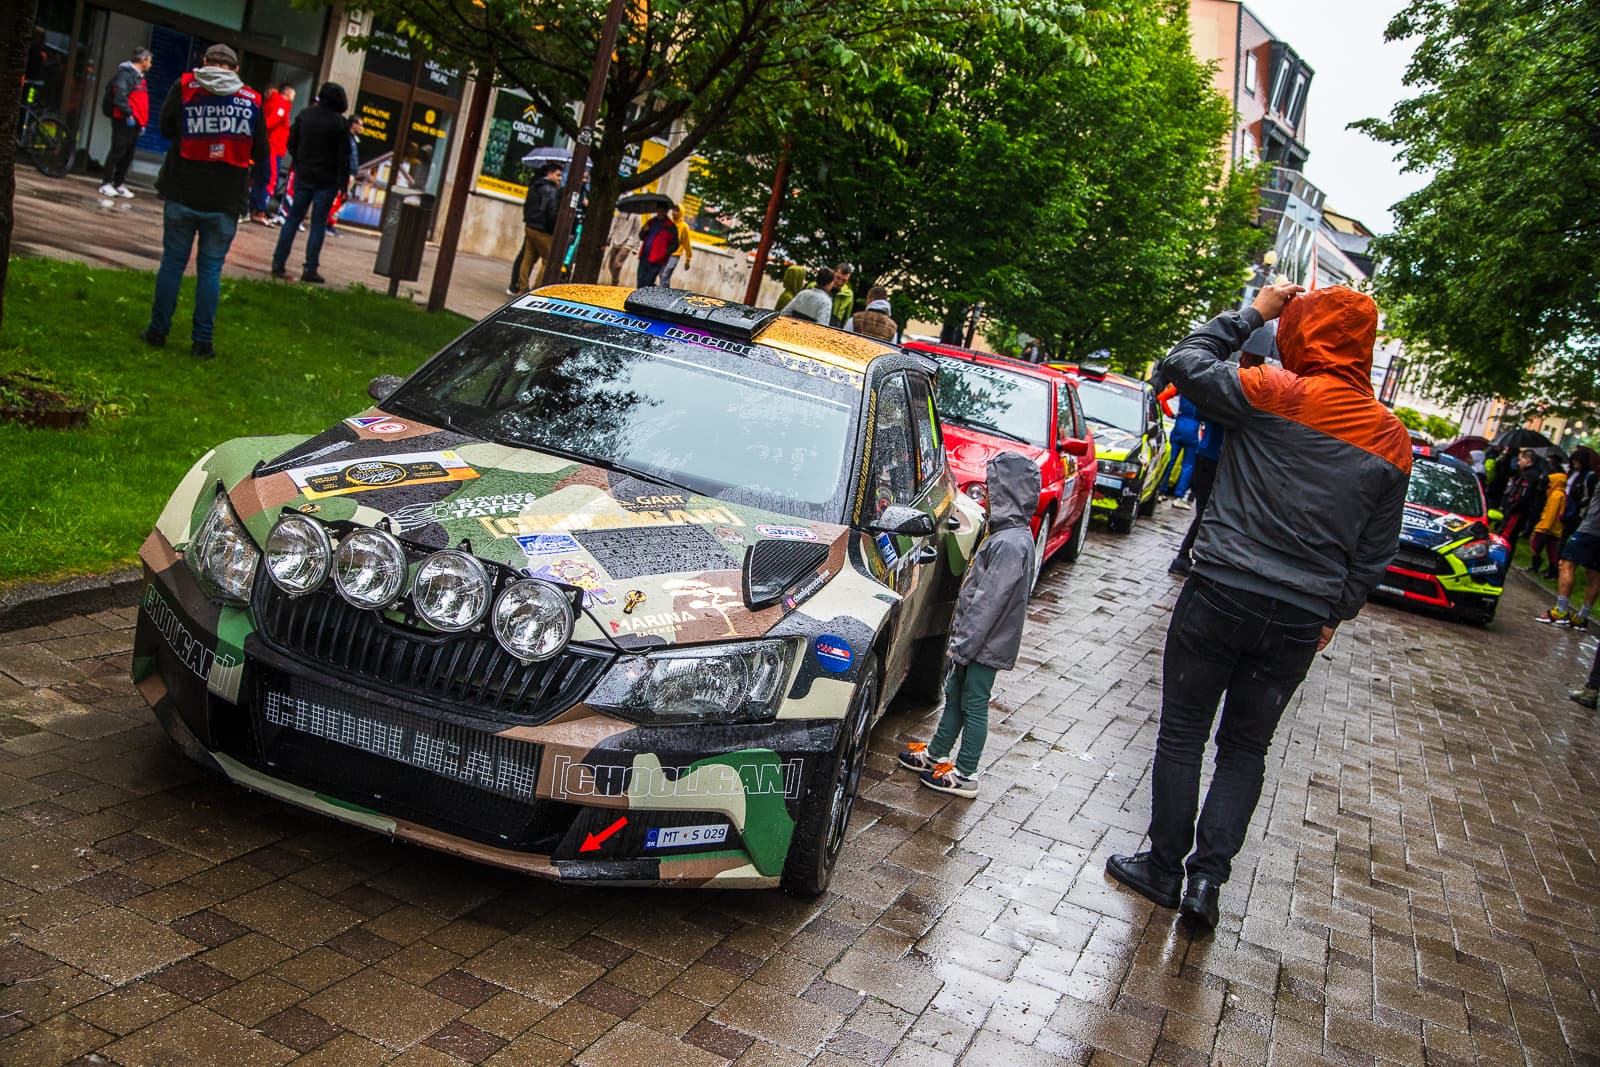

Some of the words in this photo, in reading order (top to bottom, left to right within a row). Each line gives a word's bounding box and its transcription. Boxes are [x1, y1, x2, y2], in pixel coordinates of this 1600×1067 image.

[233, 97, 251, 106] 029
[185, 104, 252, 119] TV/PHOTO
[187, 116, 252, 136] MEDIA
[512, 121, 545, 138] CENTRUM
[526, 300, 652, 330] CHOOLIGAN
[664, 327, 761, 358] RACING
[636, 495, 685, 505] GART
[451, 502, 533, 519] TATRY
[609, 610, 698, 634] MARINA
[636, 624, 683, 638] RACEWEAR
[662, 831, 680, 843] MT
[691, 829, 699, 840] S
[703, 827, 726, 840] 029
